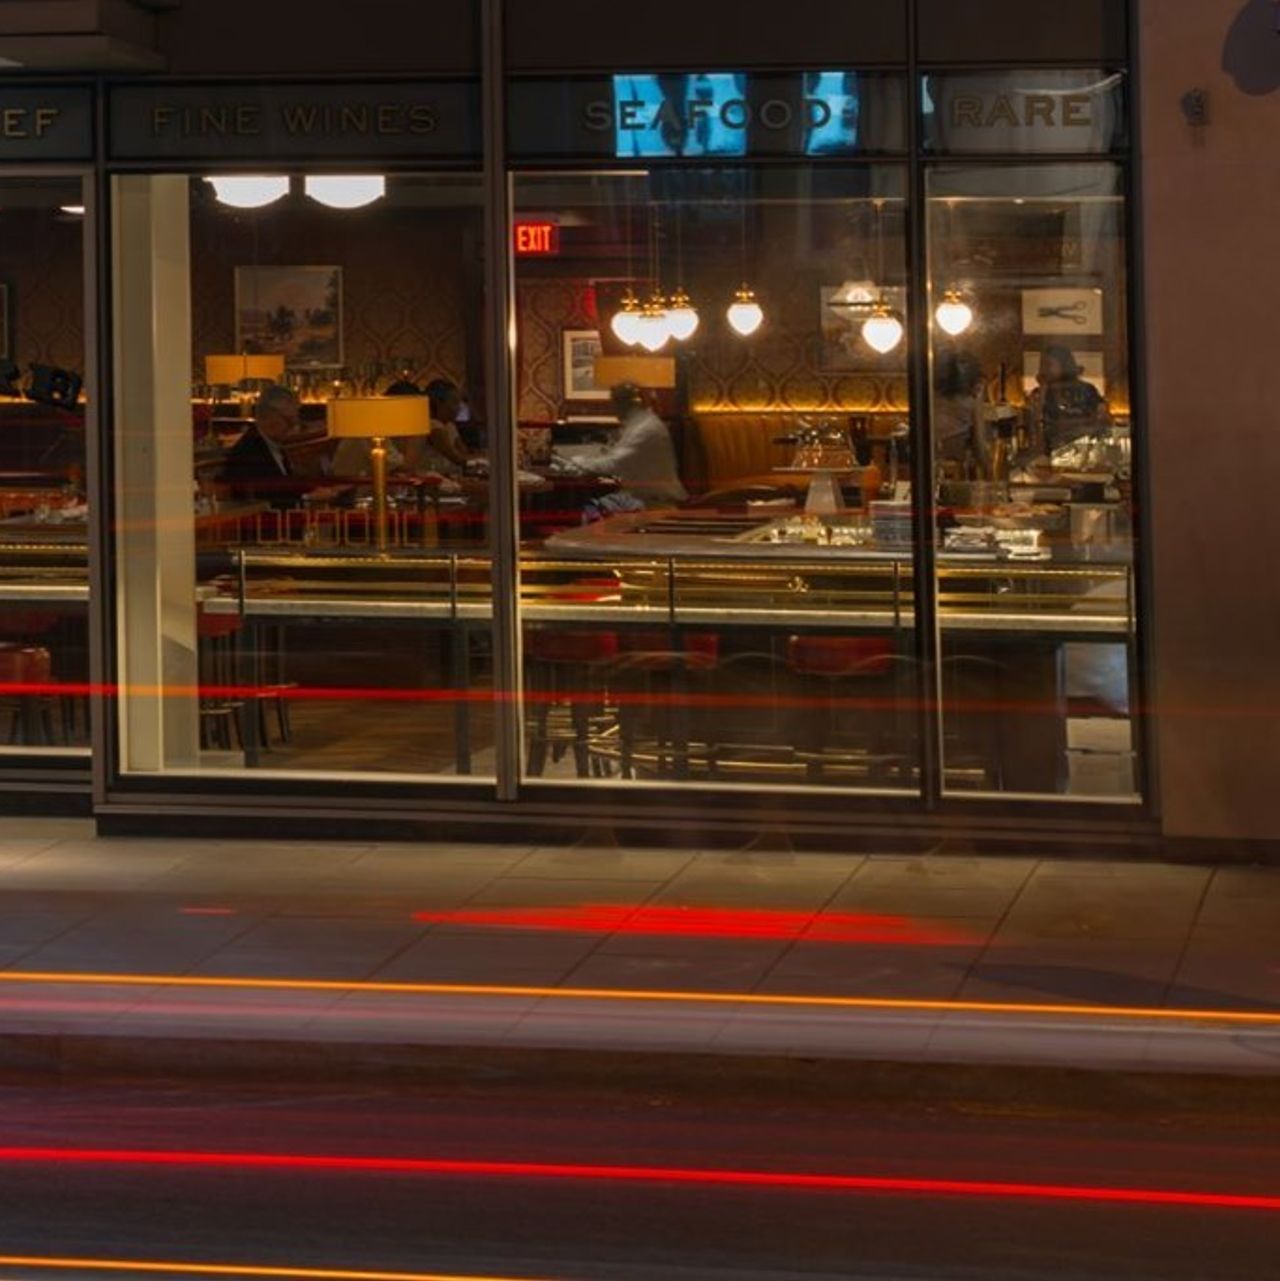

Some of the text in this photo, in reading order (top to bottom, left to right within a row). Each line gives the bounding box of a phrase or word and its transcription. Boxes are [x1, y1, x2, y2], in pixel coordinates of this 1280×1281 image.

[150, 103, 439, 137] FINE WINES
[583, 98, 833, 132] SEAFOOD
[950, 92, 1092, 128] RARE
[517, 225, 552, 252] EXIT
